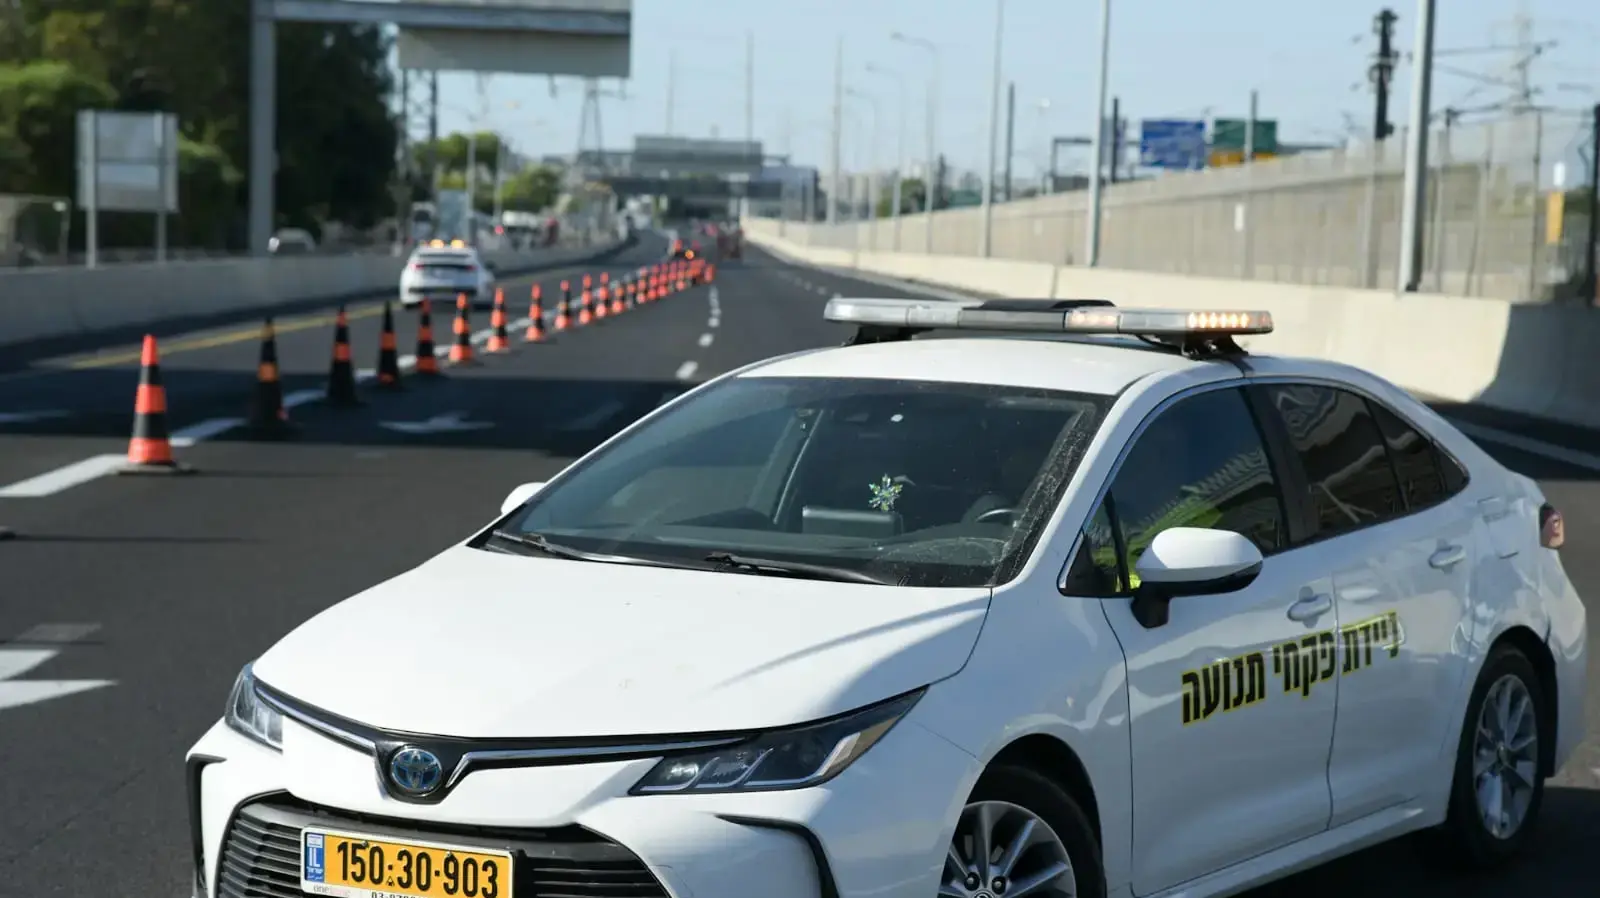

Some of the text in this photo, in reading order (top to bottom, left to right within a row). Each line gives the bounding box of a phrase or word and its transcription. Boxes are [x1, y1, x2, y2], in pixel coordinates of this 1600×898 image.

[1181, 610, 1399, 724] ניידת פקחי תנועה
[308, 847, 321, 868] IL
